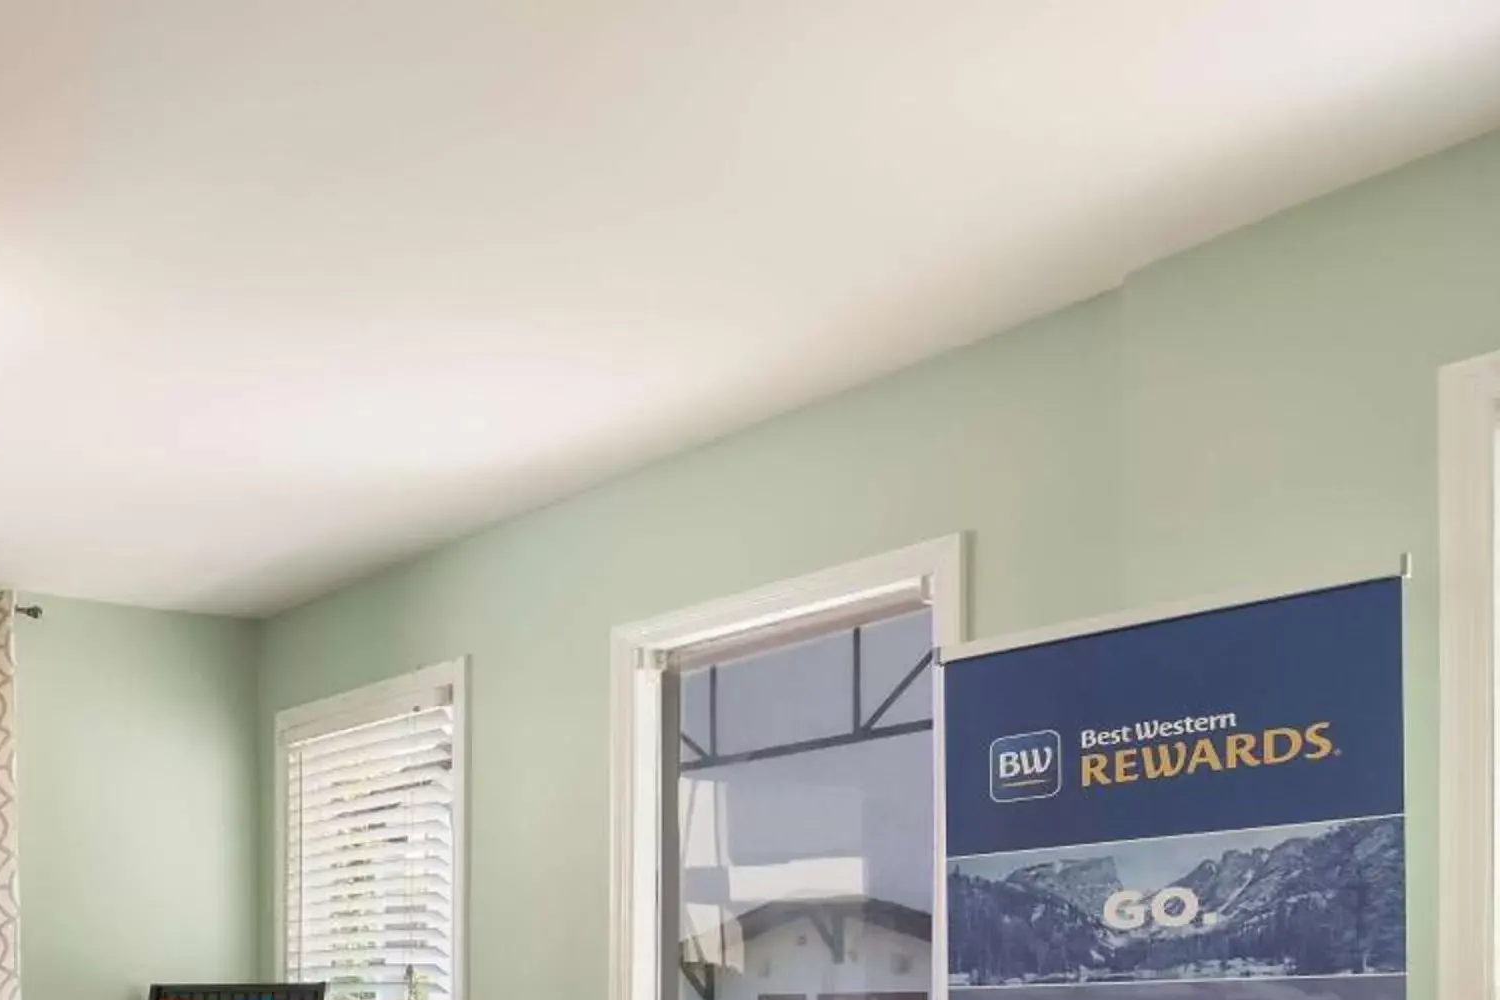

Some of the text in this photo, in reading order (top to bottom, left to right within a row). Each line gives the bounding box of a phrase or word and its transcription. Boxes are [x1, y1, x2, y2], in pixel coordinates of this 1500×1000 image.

[1081, 712, 1237, 749] Best Western
[999, 746, 1052, 778] BW
[1080, 721, 1333, 787] REWARDS
[1103, 887, 1219, 930] GO.
